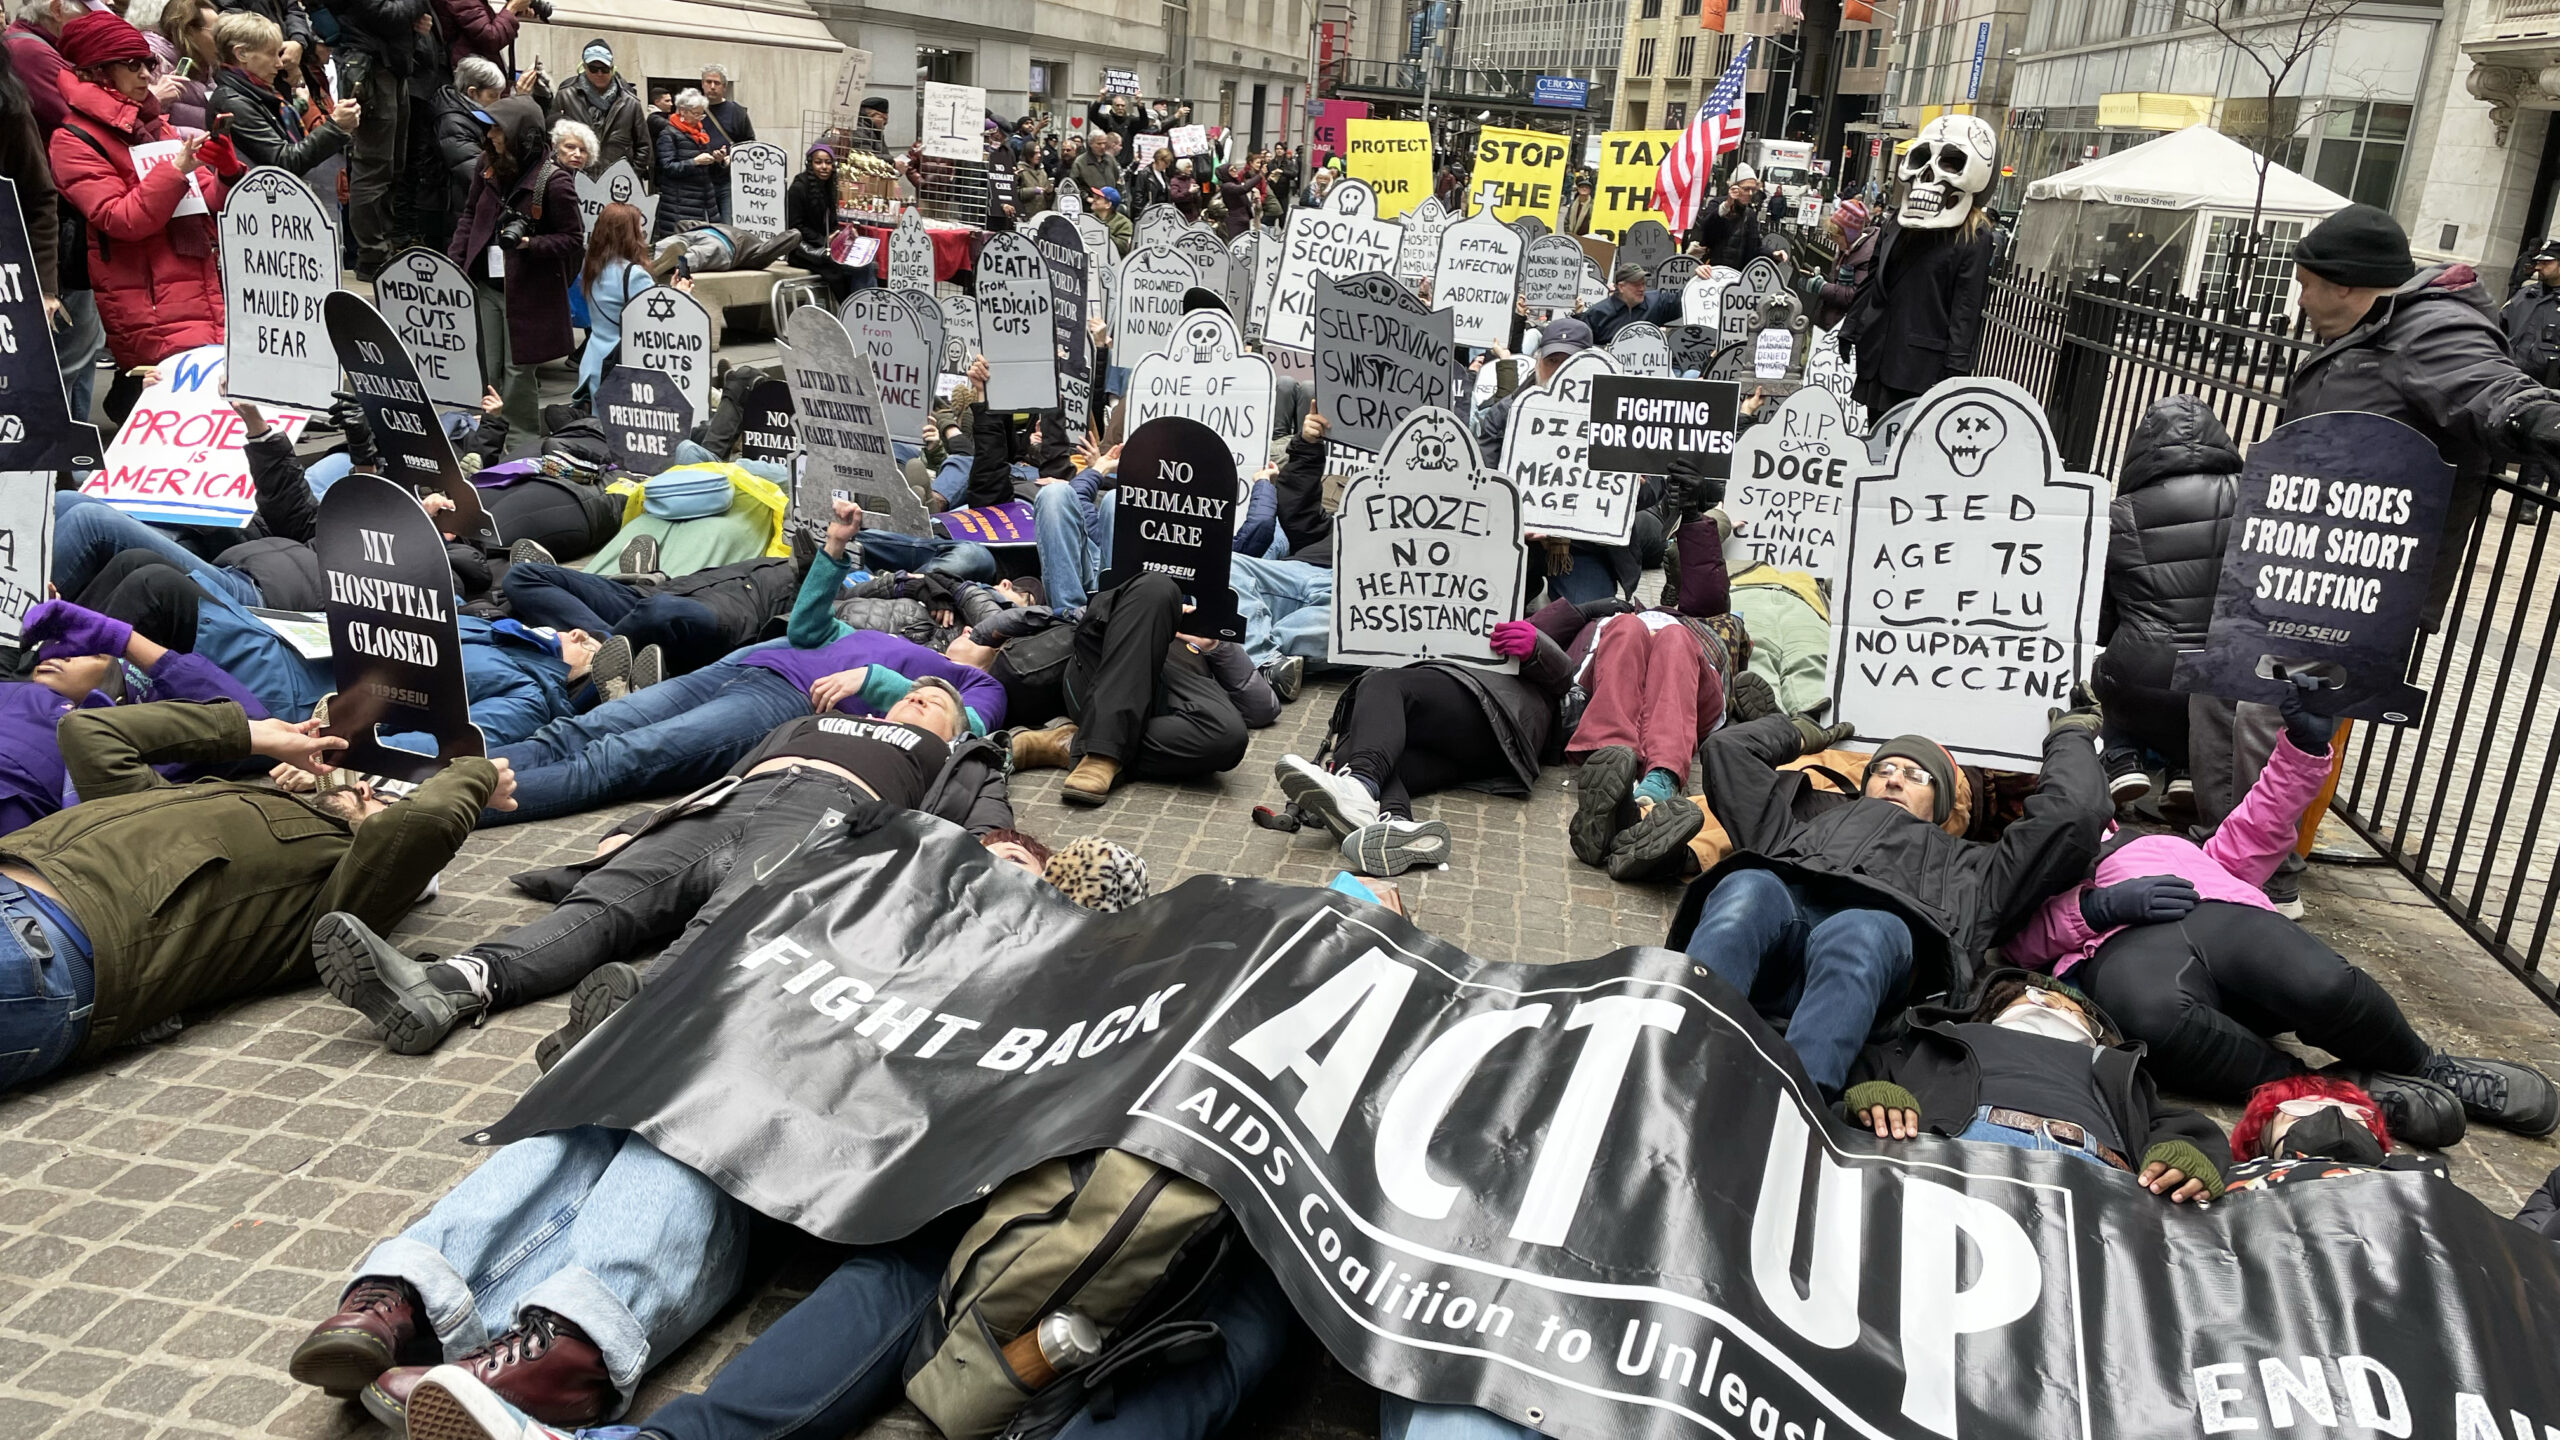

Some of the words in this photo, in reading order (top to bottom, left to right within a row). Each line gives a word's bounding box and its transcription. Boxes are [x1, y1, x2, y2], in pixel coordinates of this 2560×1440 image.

[1107, 70, 1132, 78] TRUMP
[1351, 138, 1428, 153] PROTECT
[1479, 139, 1565, 168] STOP
[739, 172, 777, 185] TRUMP
[742, 185, 777, 198] CLOSED
[750, 200, 768, 211] MY
[2113, 193, 2123, 202] 18
[2124, 194, 2150, 205] Broad
[2150, 196, 2177, 207] Street
[236, 213, 258, 236] NO
[272, 213, 314, 241] PARK
[736, 214, 778, 226] DIALYSIS
[901, 215, 922, 235] RIP
[1296, 217, 1390, 251] SOCIAL
[1460, 239, 1508, 255] FATAL
[1634, 229, 1661, 247] RIP
[244, 247, 324, 282] RANGERS:
[892, 249, 909, 264] DIED
[911, 250, 922, 264] OF
[983, 251, 1041, 280] DEATH
[1292, 240, 1393, 272] SECURITY
[1403, 248, 1425, 259] DIED
[1427, 250, 1435, 258] IN
[1448, 258, 1515, 275] INFECTION
[1528, 255, 1560, 266] NURSING
[1670, 260, 1694, 273] RIP
[892, 264, 930, 278] HUNGER
[1527, 269, 1559, 278] CLOSED
[1564, 269, 1578, 280] BY
[381, 279, 472, 309] MEDICAID
[979, 280, 1008, 296] from
[1073, 278, 1082, 297] A
[1134, 278, 1184, 293] DROWNED
[1442, 287, 1511, 305] ABORTION
[1526, 282, 1553, 293] TRUMP
[1557, 283, 1573, 292] AND
[1526, 292, 1543, 301] GOP
[242, 288, 299, 320] MAULED
[304, 297, 323, 324] BY
[855, 302, 903, 322] DIED
[1129, 296, 1144, 313] IN
[405, 305, 455, 331] CUTS
[944, 317, 975, 328] MUSK
[992, 316, 1031, 335] CUTS
[1127, 319, 1145, 335] NO
[1455, 314, 1484, 329] BAN
[1722, 316, 1745, 333] LET
[258, 325, 307, 358] BEAR
[398, 324, 466, 352] KILLED
[633, 330, 703, 352] MEDICAID
[862, 325, 893, 339] from
[1319, 307, 1450, 368] SELF-DRIVING
[354, 339, 385, 366] NO
[868, 340, 893, 357] NO
[1642, 352, 1668, 367] CALL
[1757, 351, 1788, 360] DENIED
[415, 352, 451, 380] ME
[642, 353, 693, 372] CUTS
[349, 371, 425, 405] PRIMARY
[796, 368, 836, 393] LIVED
[838, 374, 852, 395] IN
[854, 376, 866, 397] A
[1151, 376, 1193, 397] ONE
[1206, 377, 1237, 396] OF
[1322, 350, 1445, 406] SWASTICAR
[1813, 373, 1853, 395] BIRD
[631, 382, 655, 405] NO
[381, 407, 428, 436] CARE
[608, 405, 681, 433] PREVENTATIVE
[766, 410, 790, 428] NO
[801, 396, 875, 426] MATERNITY
[1617, 396, 1709, 426] FIGHTING
[1784, 408, 1836, 441] R.I.P.
[625, 431, 669, 457] CARE
[804, 424, 838, 448] CARE
[838, 429, 887, 455] DESERT
[1589, 422, 1627, 448] FOR
[1631, 425, 1673, 451] OUR
[1678, 428, 1734, 454] LIVES
[187, 450, 208, 463] IS
[402, 453, 440, 470] 1199SEIU
[1557, 445, 1588, 464] OF
[833, 464, 873, 478] 1199SEIU
[1157, 458, 1194, 485] NO
[1515, 460, 1628, 496] MEASLES
[1752, 450, 1848, 489] DOGE
[1119, 484, 1229, 520] PRIMARY
[1521, 489, 1580, 512] AGE
[1595, 498, 1610, 518] 4
[1890, 494, 2036, 525] DIED
[2266, 473, 2321, 514] BED
[2325, 480, 2413, 525] SORES
[1365, 493, 1492, 537] FROZE.
[1764, 507, 1803, 524] MY
[1140, 519, 1203, 548] CARE
[2240, 516, 2321, 560] FROM
[2324, 527, 2419, 573] SHORT
[360, 528, 396, 567] MY
[1391, 538, 1451, 568] NO
[1746, 543, 1819, 568] TRIAL
[1873, 542, 1955, 570] AGE
[1991, 541, 2044, 576] 75
[1142, 561, 1196, 578] 1199SEIU
[326, 569, 448, 623] HOSPITAL
[1356, 571, 1489, 602] HEATING
[2256, 564, 2382, 614] STAFFING
[1873, 588, 1925, 611] OF
[1957, 590, 2044, 616] FLU
[1349, 603, 1499, 638] ASSISTANCE
[2267, 620, 2351, 643] 1199SEIU
[348, 621, 439, 668] CLOSED
[1855, 629, 1897, 655] NO
[1906, 632, 2065, 664] UPDATED
[1861, 661, 2072, 700] VACCINE
[371, 682, 430, 706] 1199SEIU
[739, 934, 982, 1059] FIGHT
[976, 982, 1187, 1076] BACK
[1228, 945, 1686, 1248] ACT
[1750, 1086, 2043, 1440] UP
[1174, 1086, 1295, 1188] AIDS
[1299, 1191, 1515, 1338] Coalition
[1534, 1312, 1593, 1365] to
[2193, 1353, 2413, 1439] END
